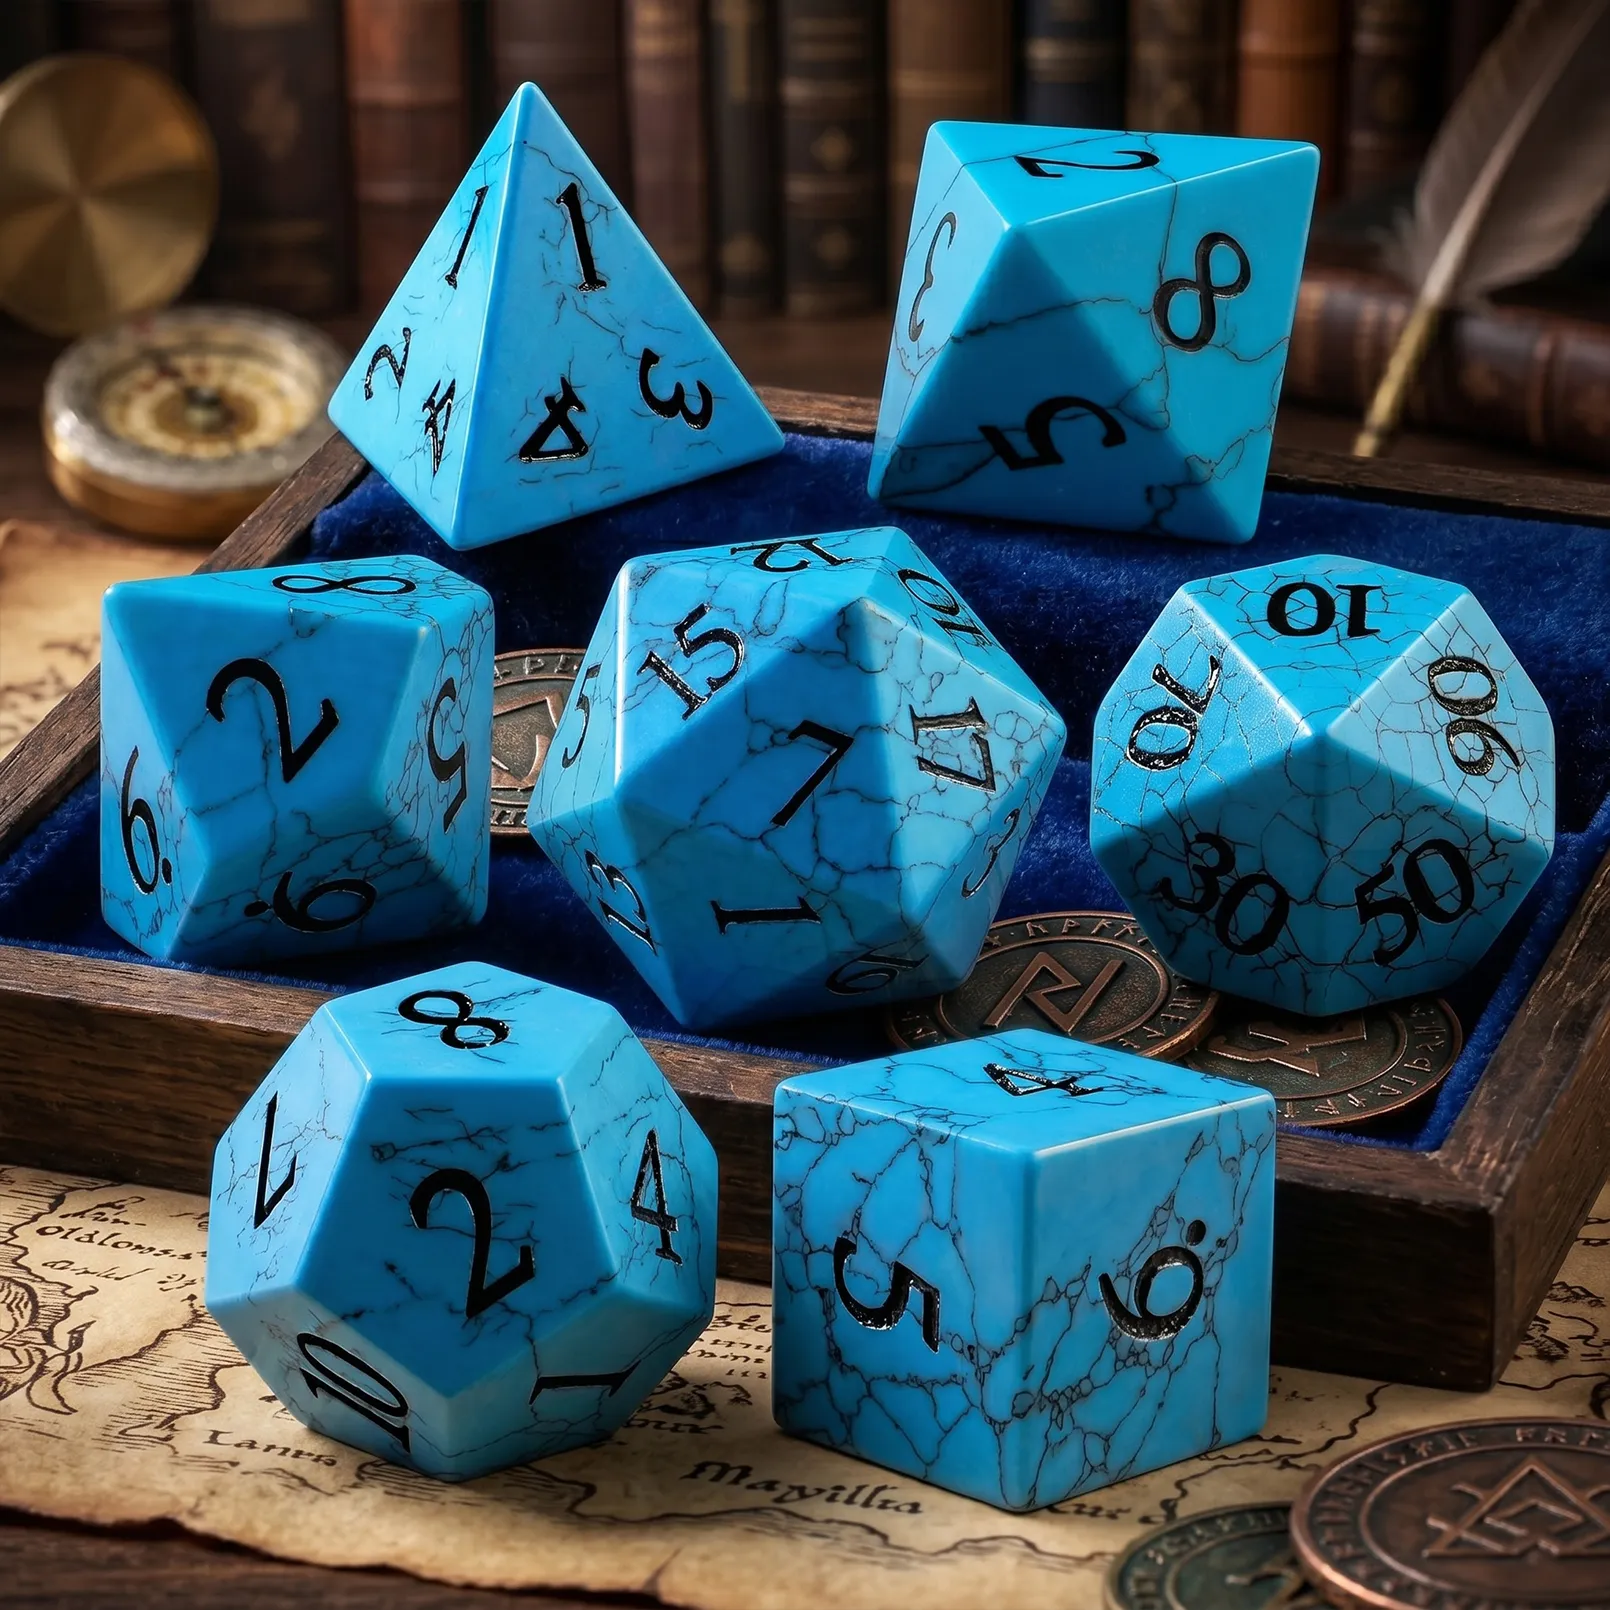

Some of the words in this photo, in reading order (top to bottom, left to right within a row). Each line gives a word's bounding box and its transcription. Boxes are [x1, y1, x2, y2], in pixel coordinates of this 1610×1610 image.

[1013, 150, 1160, 178] 2
[445, 185, 489, 290] 1
[556, 182, 607, 293] 1
[908, 211, 957, 342] 3
[1152, 231, 1252, 352] 8
[364, 327, 411, 400] 2
[638, 347, 714, 432] 3
[518, 374, 589, 463] 4
[978, 395, 1127, 472] 5
[271, 575, 417, 596] 8
[730, 537, 854, 573] 12
[637, 603, 746, 721] 15
[1266, 581, 1382, 638] 10
[206, 657, 340, 784] 2
[427, 676, 468, 835] 5
[562, 664, 601, 768] 5
[908, 697, 996, 794] 17
[1124, 655, 1219, 771] 70
[1427, 655, 1521, 776] 90
[770, 719, 855, 828] 7
[710, 895, 822, 936] 1
[1152, 831, 1291, 956] 30
[1353, 838, 1475, 967] 50
[398, 989, 510, 1050] 8
[982, 1063, 1104, 1097] 4
[409, 1167, 536, 1320] 2
[630, 1128, 683, 1267] 4
[833, 1235, 940, 1354] 5
[296, 1332, 411, 1454] 10
[528, 1360, 643, 1406] 1
